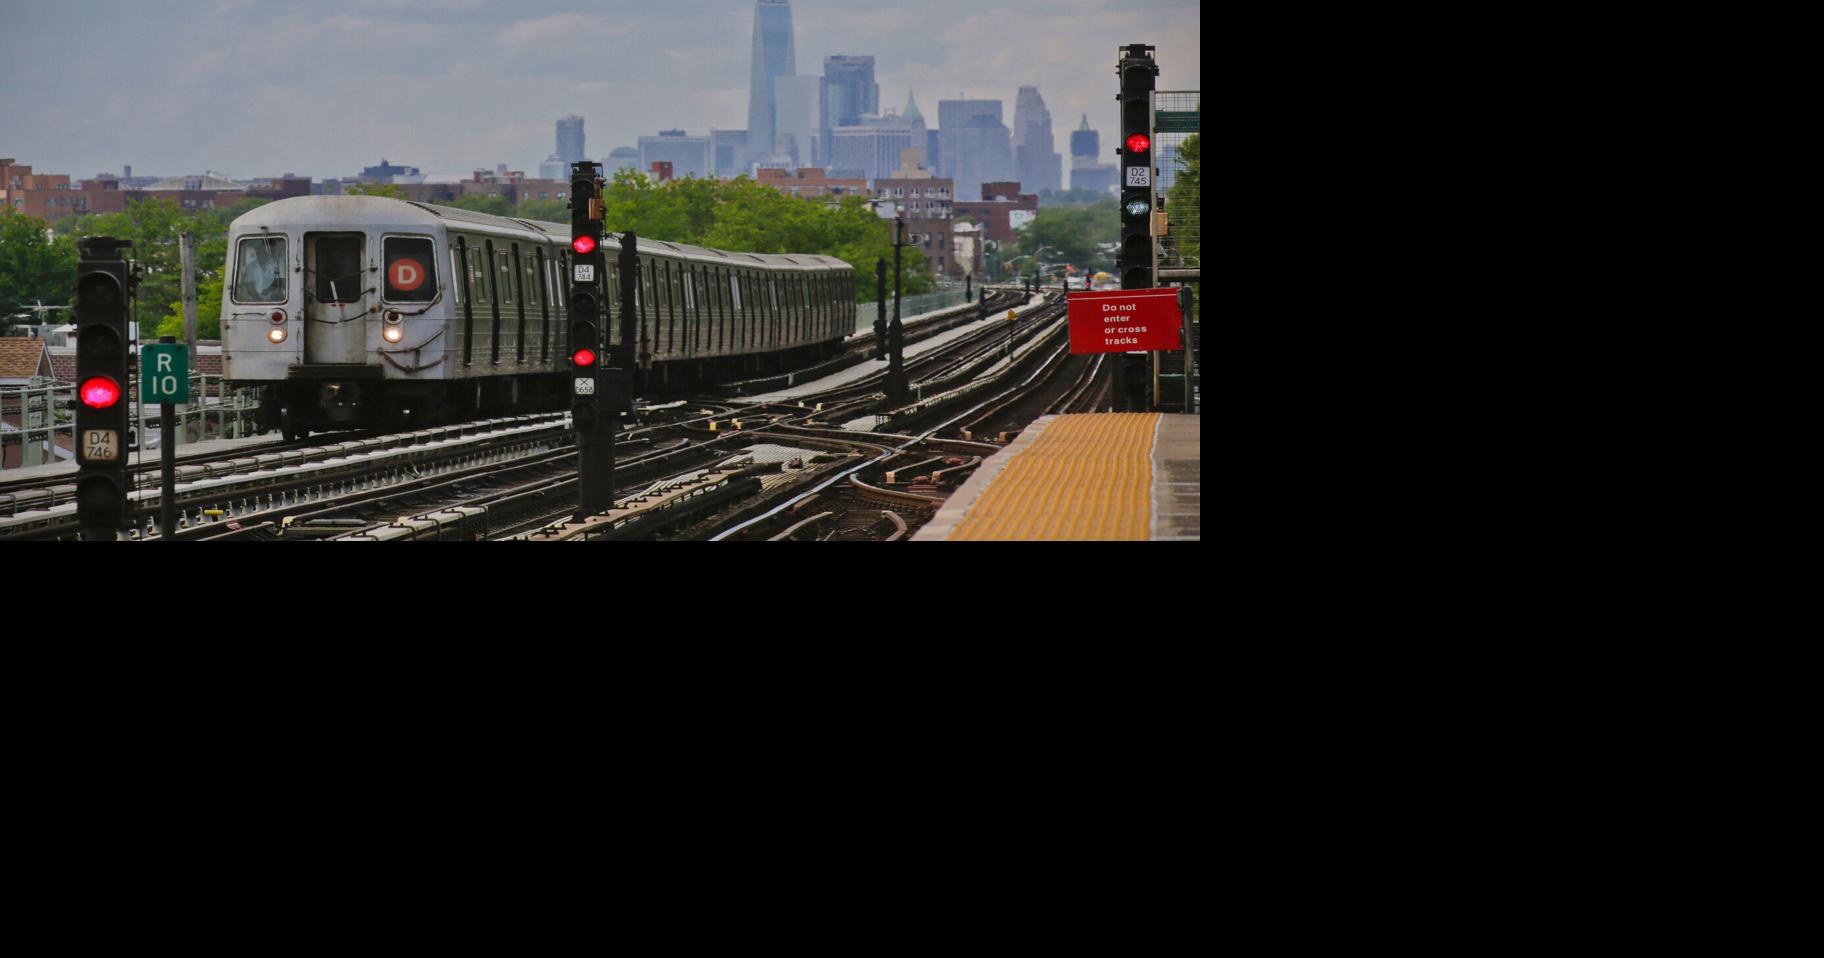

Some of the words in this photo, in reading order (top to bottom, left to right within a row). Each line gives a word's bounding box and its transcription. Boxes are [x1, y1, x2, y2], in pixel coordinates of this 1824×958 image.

[1132, 168, 1144, 176] D2
[1130, 177, 1147, 185] 745
[398, 266, 417, 285] D
[1102, 304, 1117, 312] Do
[1119, 303, 1136, 311] not
[1104, 314, 1131, 323] enter
[1118, 326, 1148, 334] cross
[1104, 336, 1138, 345] tracks
[157, 353, 172, 372] R
[152, 376, 178, 395] 10
[90, 432, 110, 445] D4
[87, 446, 112, 458] 746
